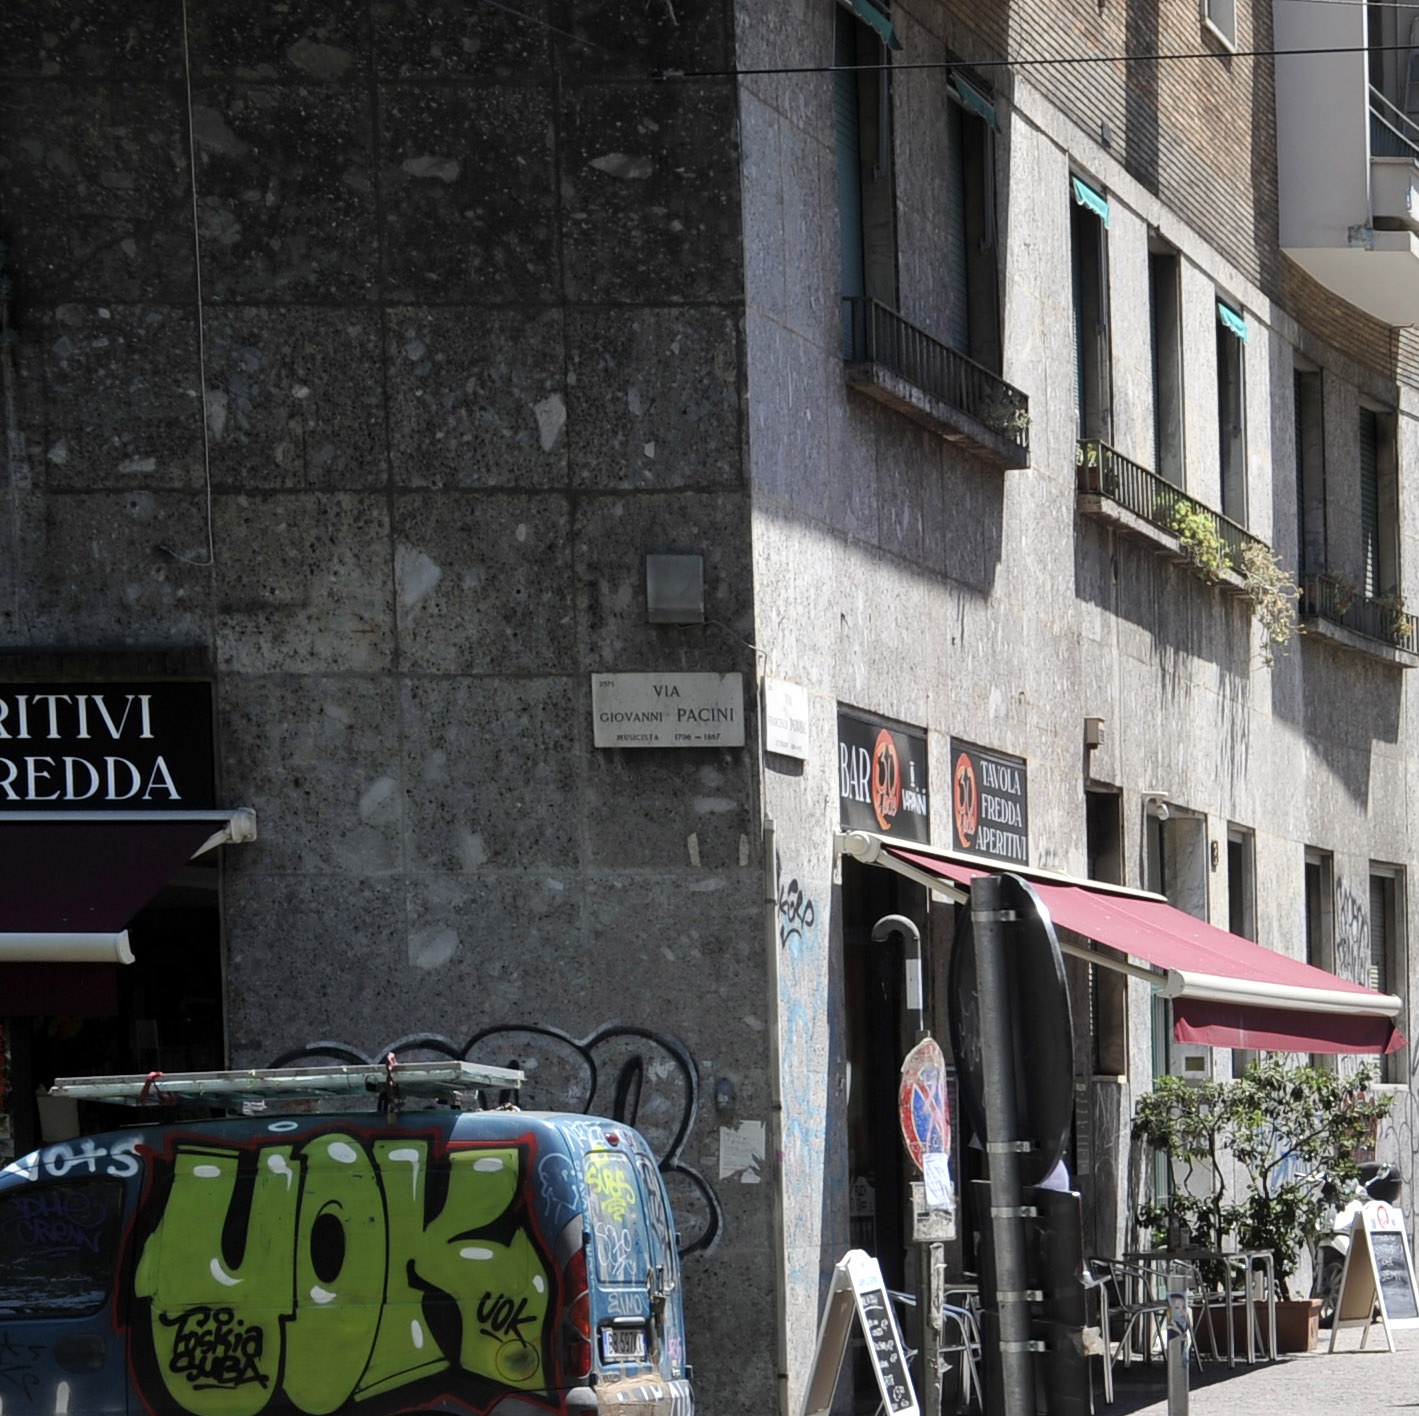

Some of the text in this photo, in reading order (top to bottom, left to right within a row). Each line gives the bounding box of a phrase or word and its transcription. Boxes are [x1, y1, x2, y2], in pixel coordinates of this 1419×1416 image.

[653, 685, 680, 697] VIA
[600, 707, 734, 723] GIOVANNI PACINI
[616, 733, 659, 742] MUSICISTA
[839, 741, 872, 804] BAR
[979, 760, 1022, 796] TAVOLA
[981, 793, 1023, 829] FREDDA
[975, 825, 1028, 862] APERITIVI
